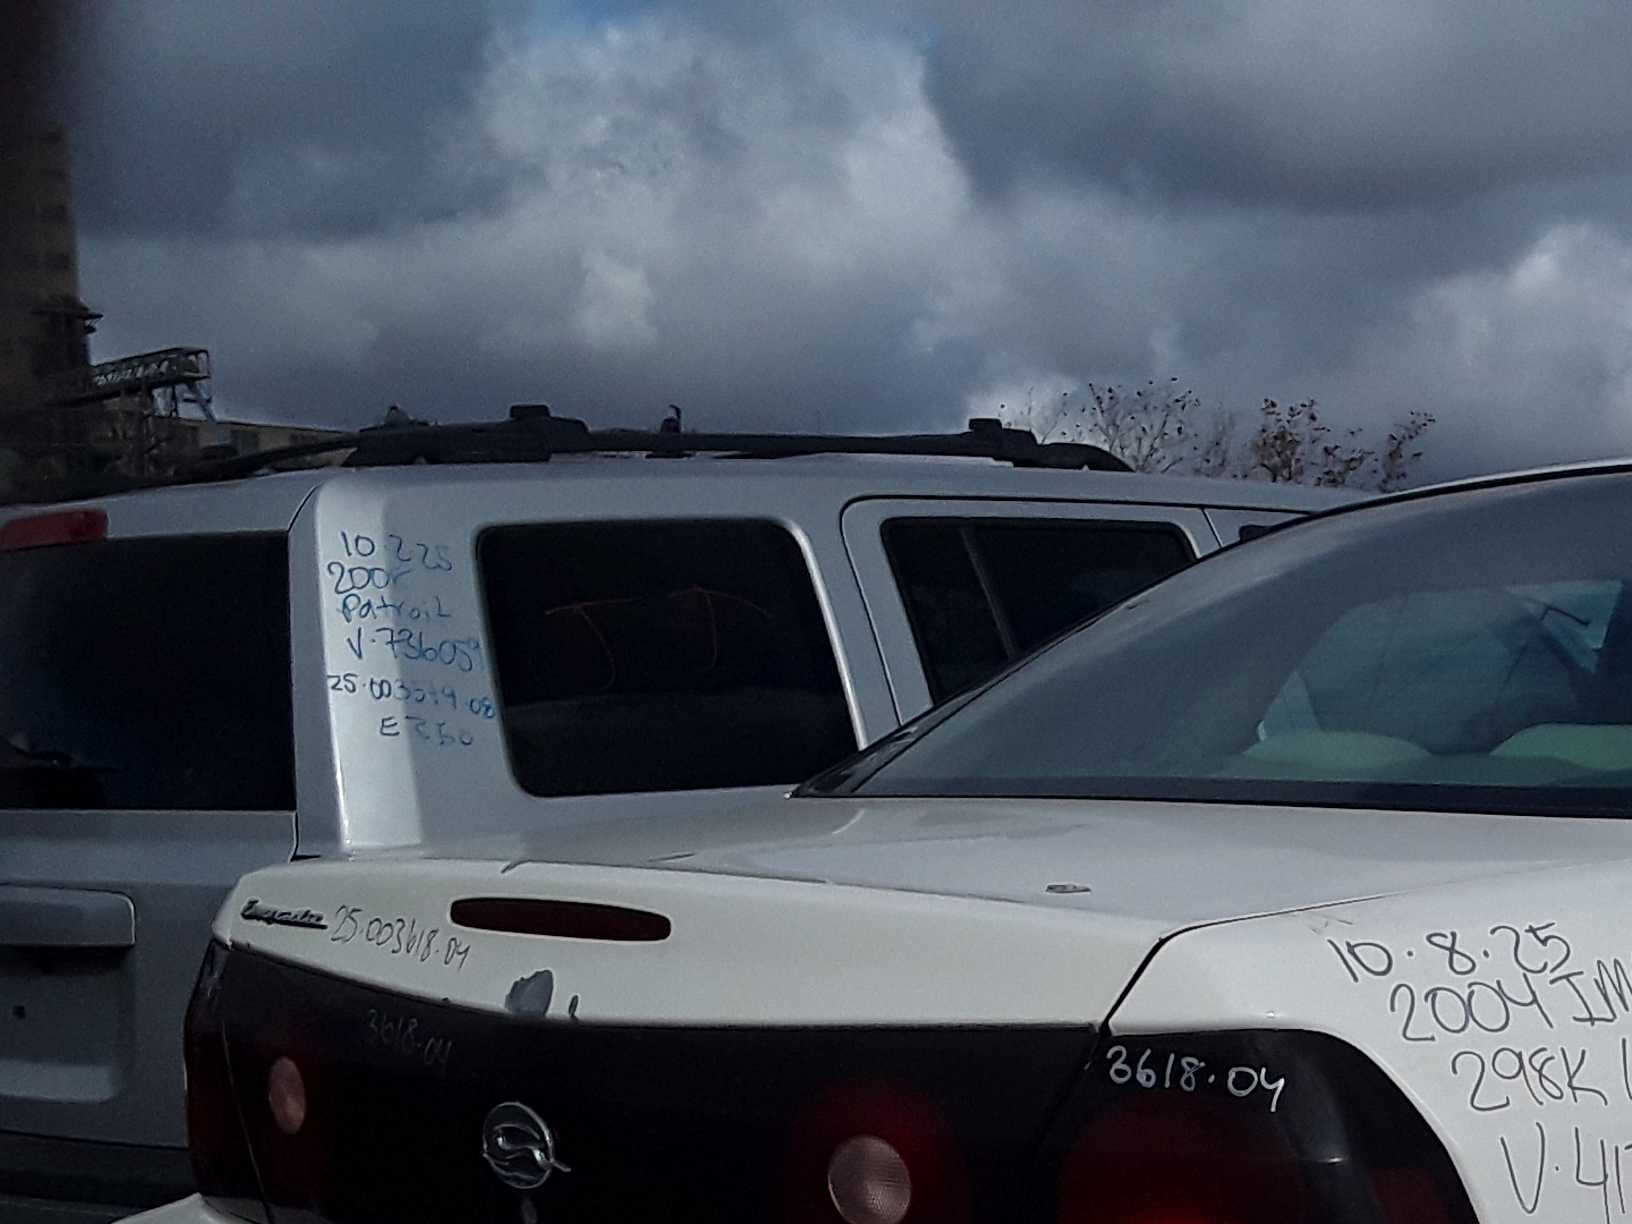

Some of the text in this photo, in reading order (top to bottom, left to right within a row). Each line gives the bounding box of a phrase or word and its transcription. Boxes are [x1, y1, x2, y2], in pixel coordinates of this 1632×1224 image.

[1328, 923, 1571, 982] 10.8.25
[1390, 973, 1555, 1041] 2004
[1451, 1046, 1608, 1111] 298K
